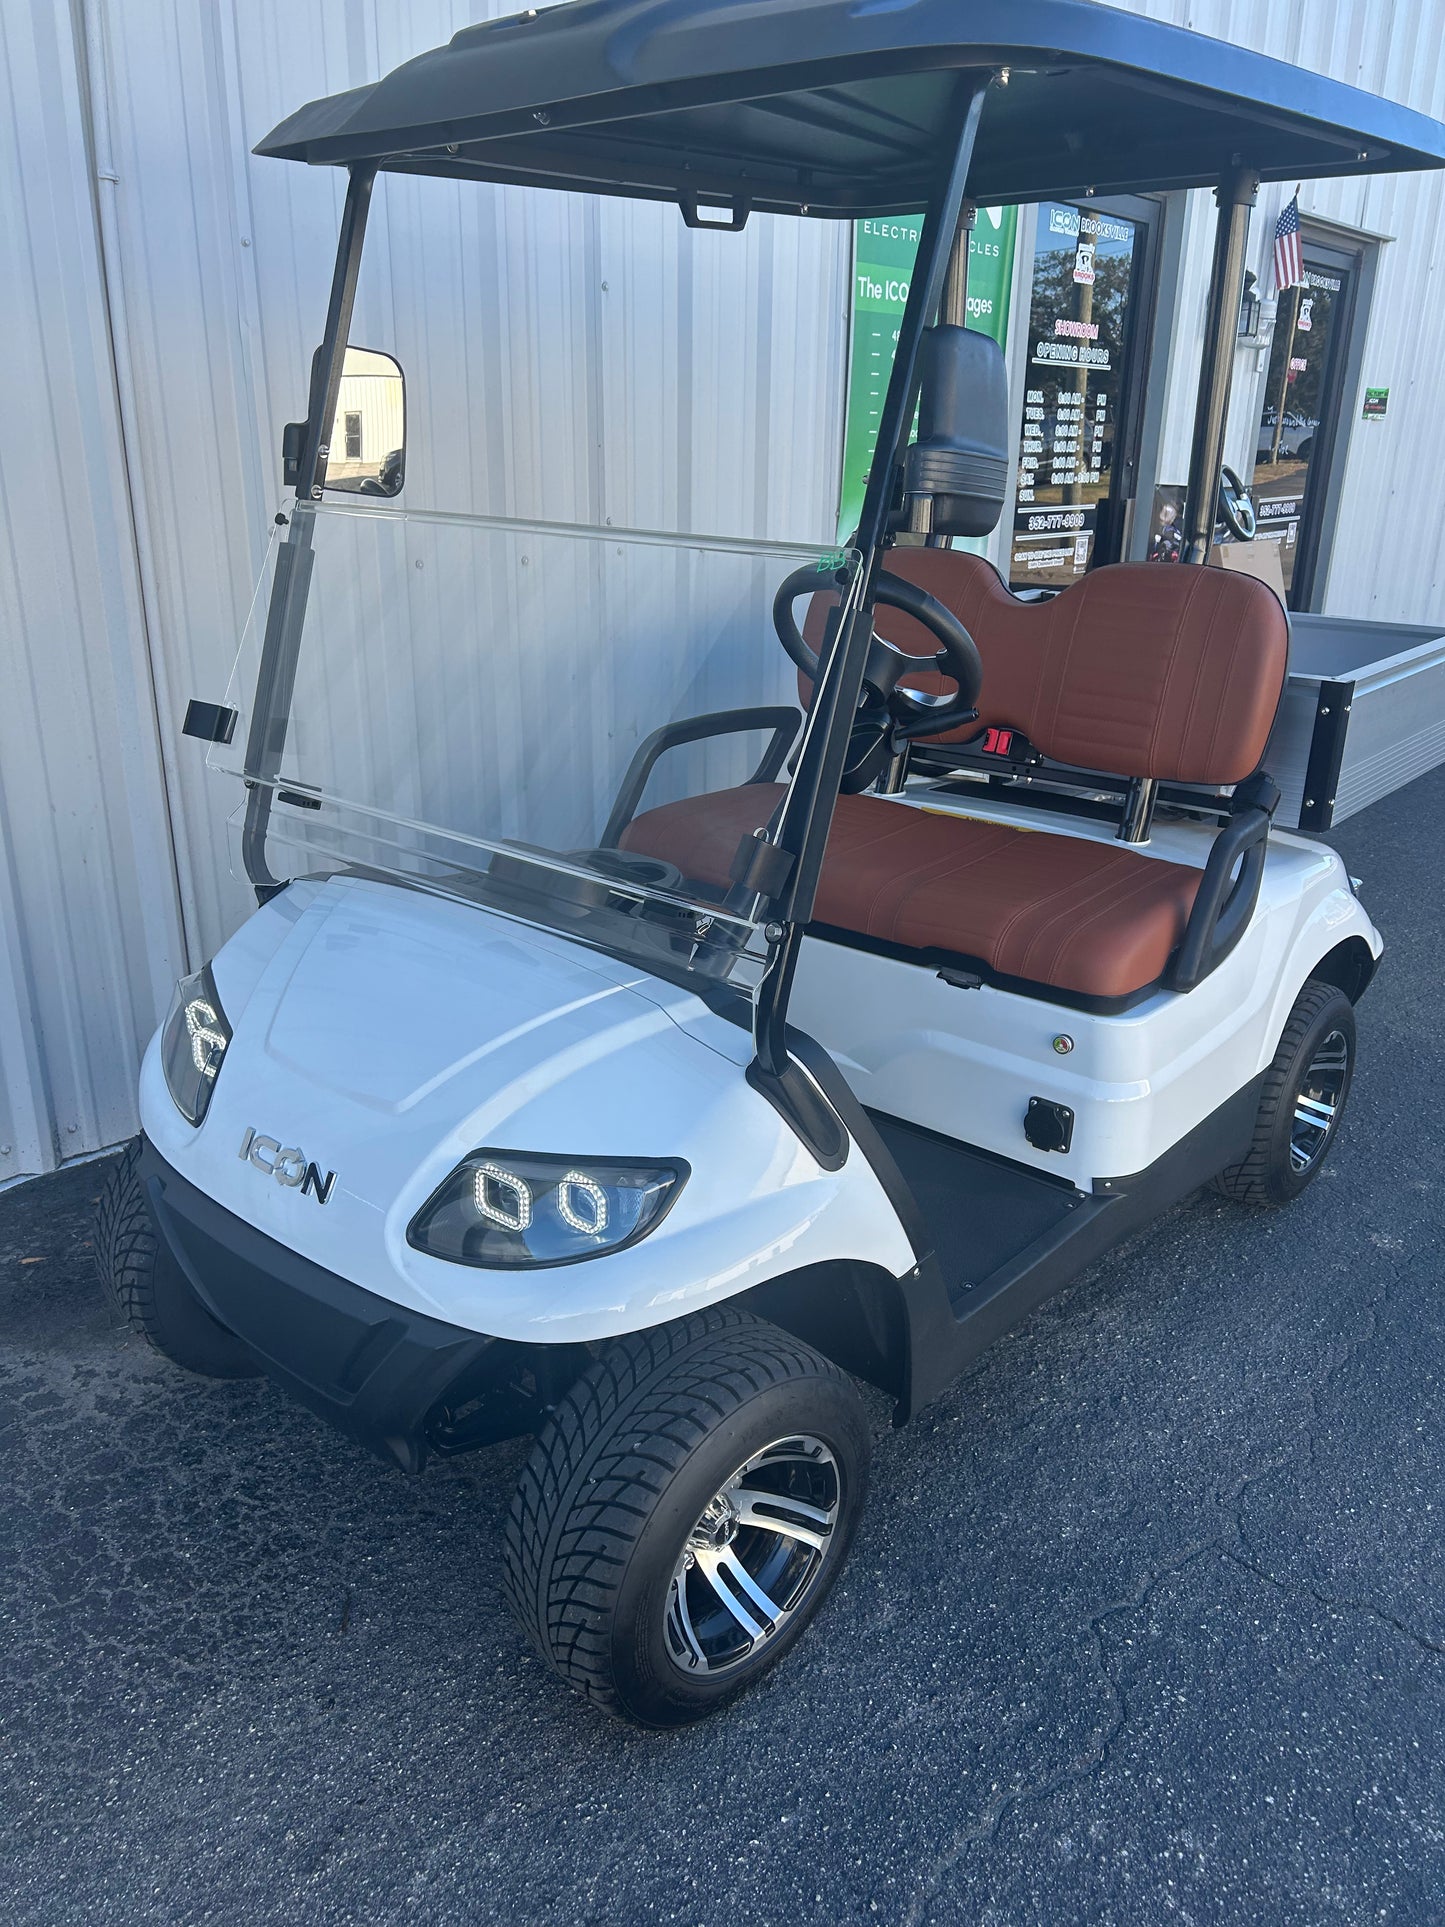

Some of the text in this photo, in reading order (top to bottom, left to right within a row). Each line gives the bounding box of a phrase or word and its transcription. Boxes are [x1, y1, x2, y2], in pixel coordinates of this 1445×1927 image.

[864, 221, 921, 242] ELECTR
[1051, 209, 1081, 231] ICON
[1081, 218, 1129, 241] BROOKSVILLE
[858, 276, 882, 299] The
[885, 280, 910, 303] ICO
[1055, 319, 1098, 339] SHOWROOM
[1037, 342, 1109, 364] OPENING HOURS
[1027, 390, 1044, 404] MON.
[1026, 407, 1045, 420] TUES.
[1019, 489, 1035, 502] SUN.
[1028, 513, 1085, 531] 352-777-9909
[238, 1126, 338, 1205] ICON
